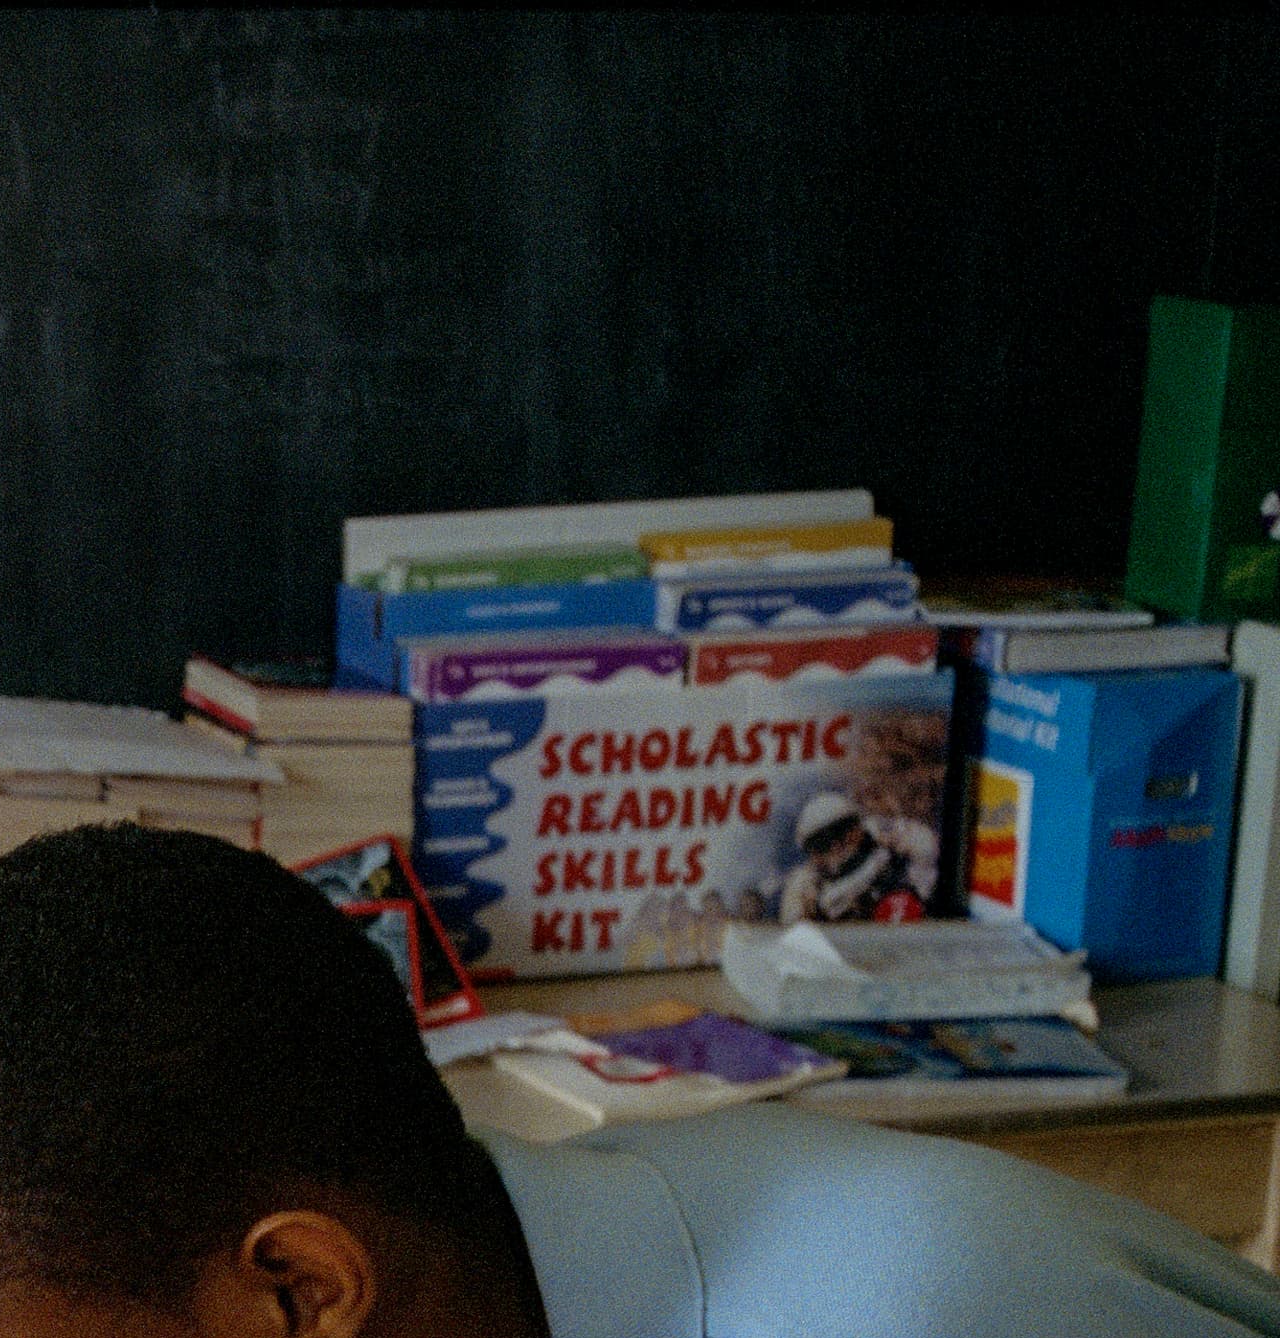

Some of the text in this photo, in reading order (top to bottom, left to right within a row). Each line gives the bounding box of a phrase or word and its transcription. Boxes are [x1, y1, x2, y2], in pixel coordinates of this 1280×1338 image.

[540, 714, 851, 779] SCHOLASTIC
[536, 779, 771, 838] READING
[533, 841, 706, 896] SKILLS
[531, 906, 621, 951] KIT
